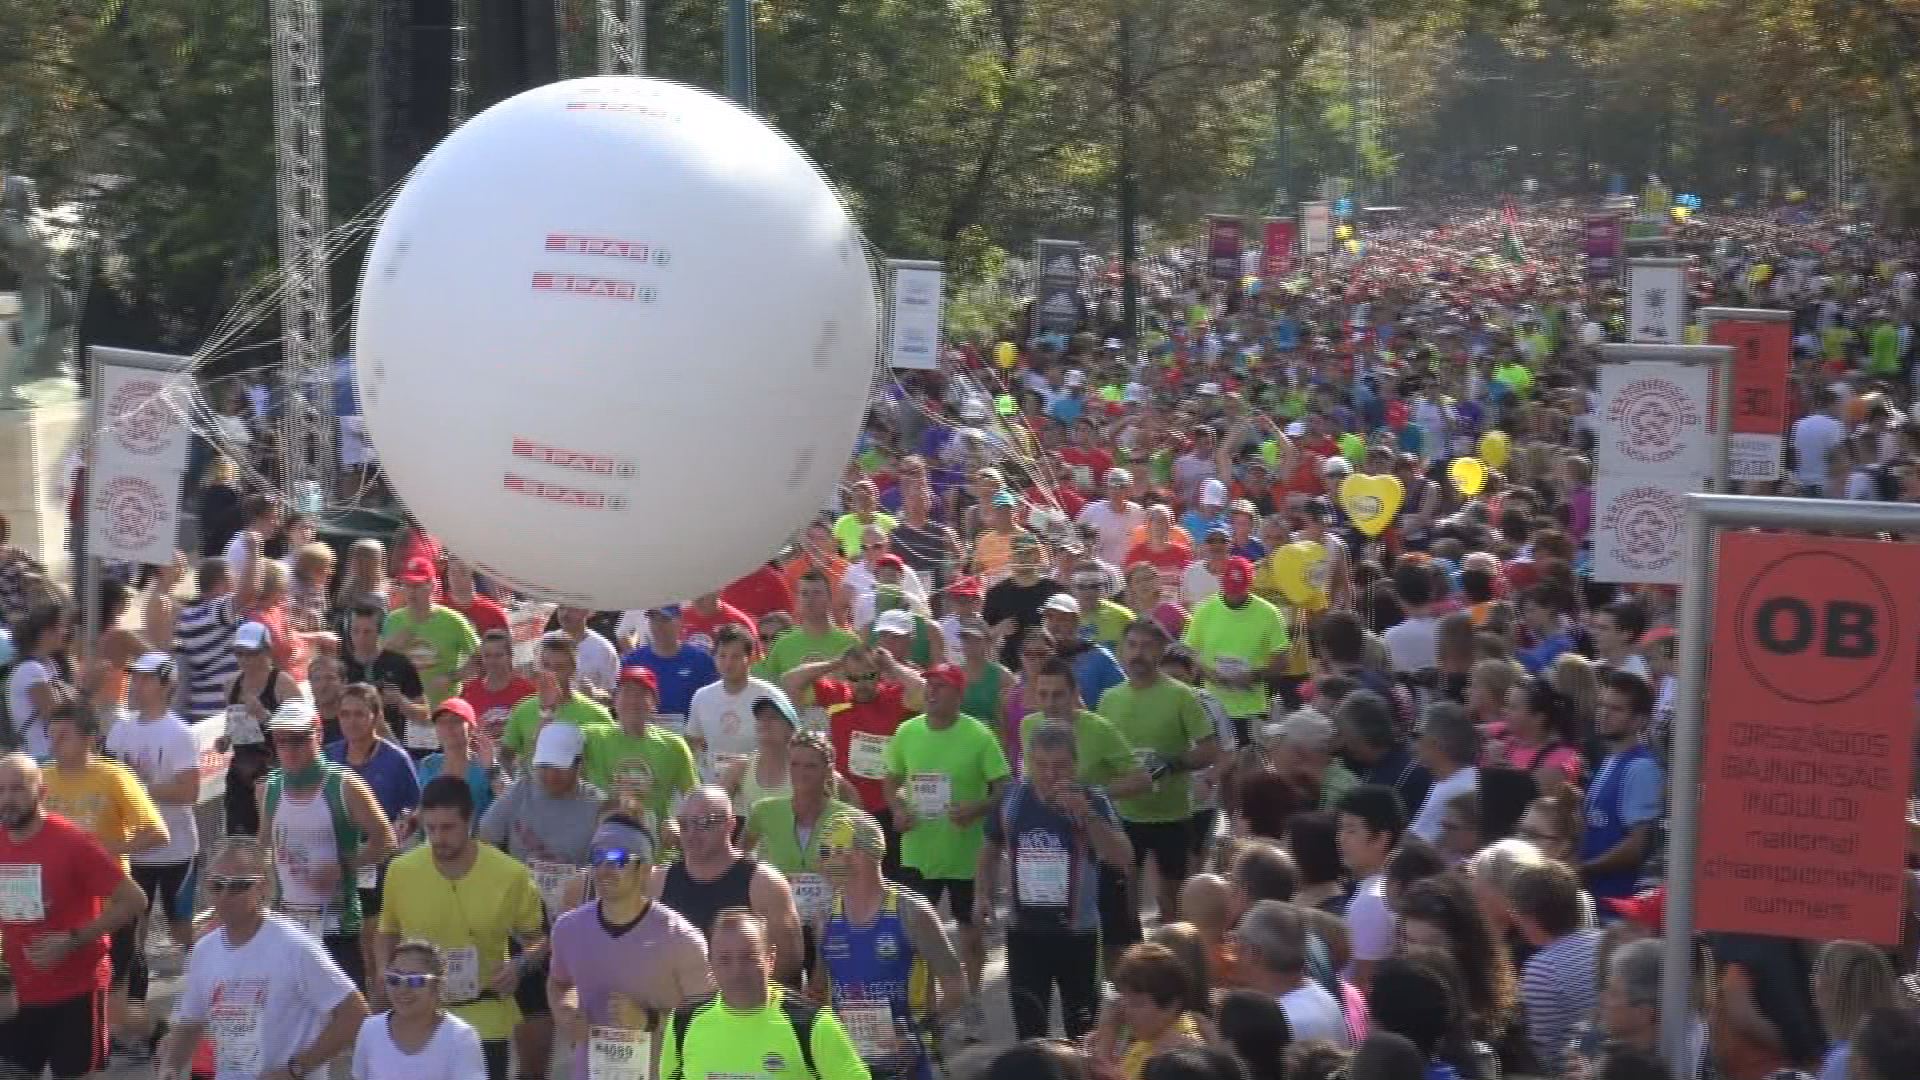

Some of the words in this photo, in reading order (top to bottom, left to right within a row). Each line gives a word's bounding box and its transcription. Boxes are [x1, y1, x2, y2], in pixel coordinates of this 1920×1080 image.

[563, 236, 649, 263] SPAR
[549, 273, 635, 300] SPAR
[529, 444, 612, 476] SPAR
[520, 478, 602, 511] SPAR
[1754, 595, 1880, 660] OB
[1745, 824, 1860, 854] national
[1703, 854, 1897, 895] championship
[1743, 894, 1853, 922] runners
